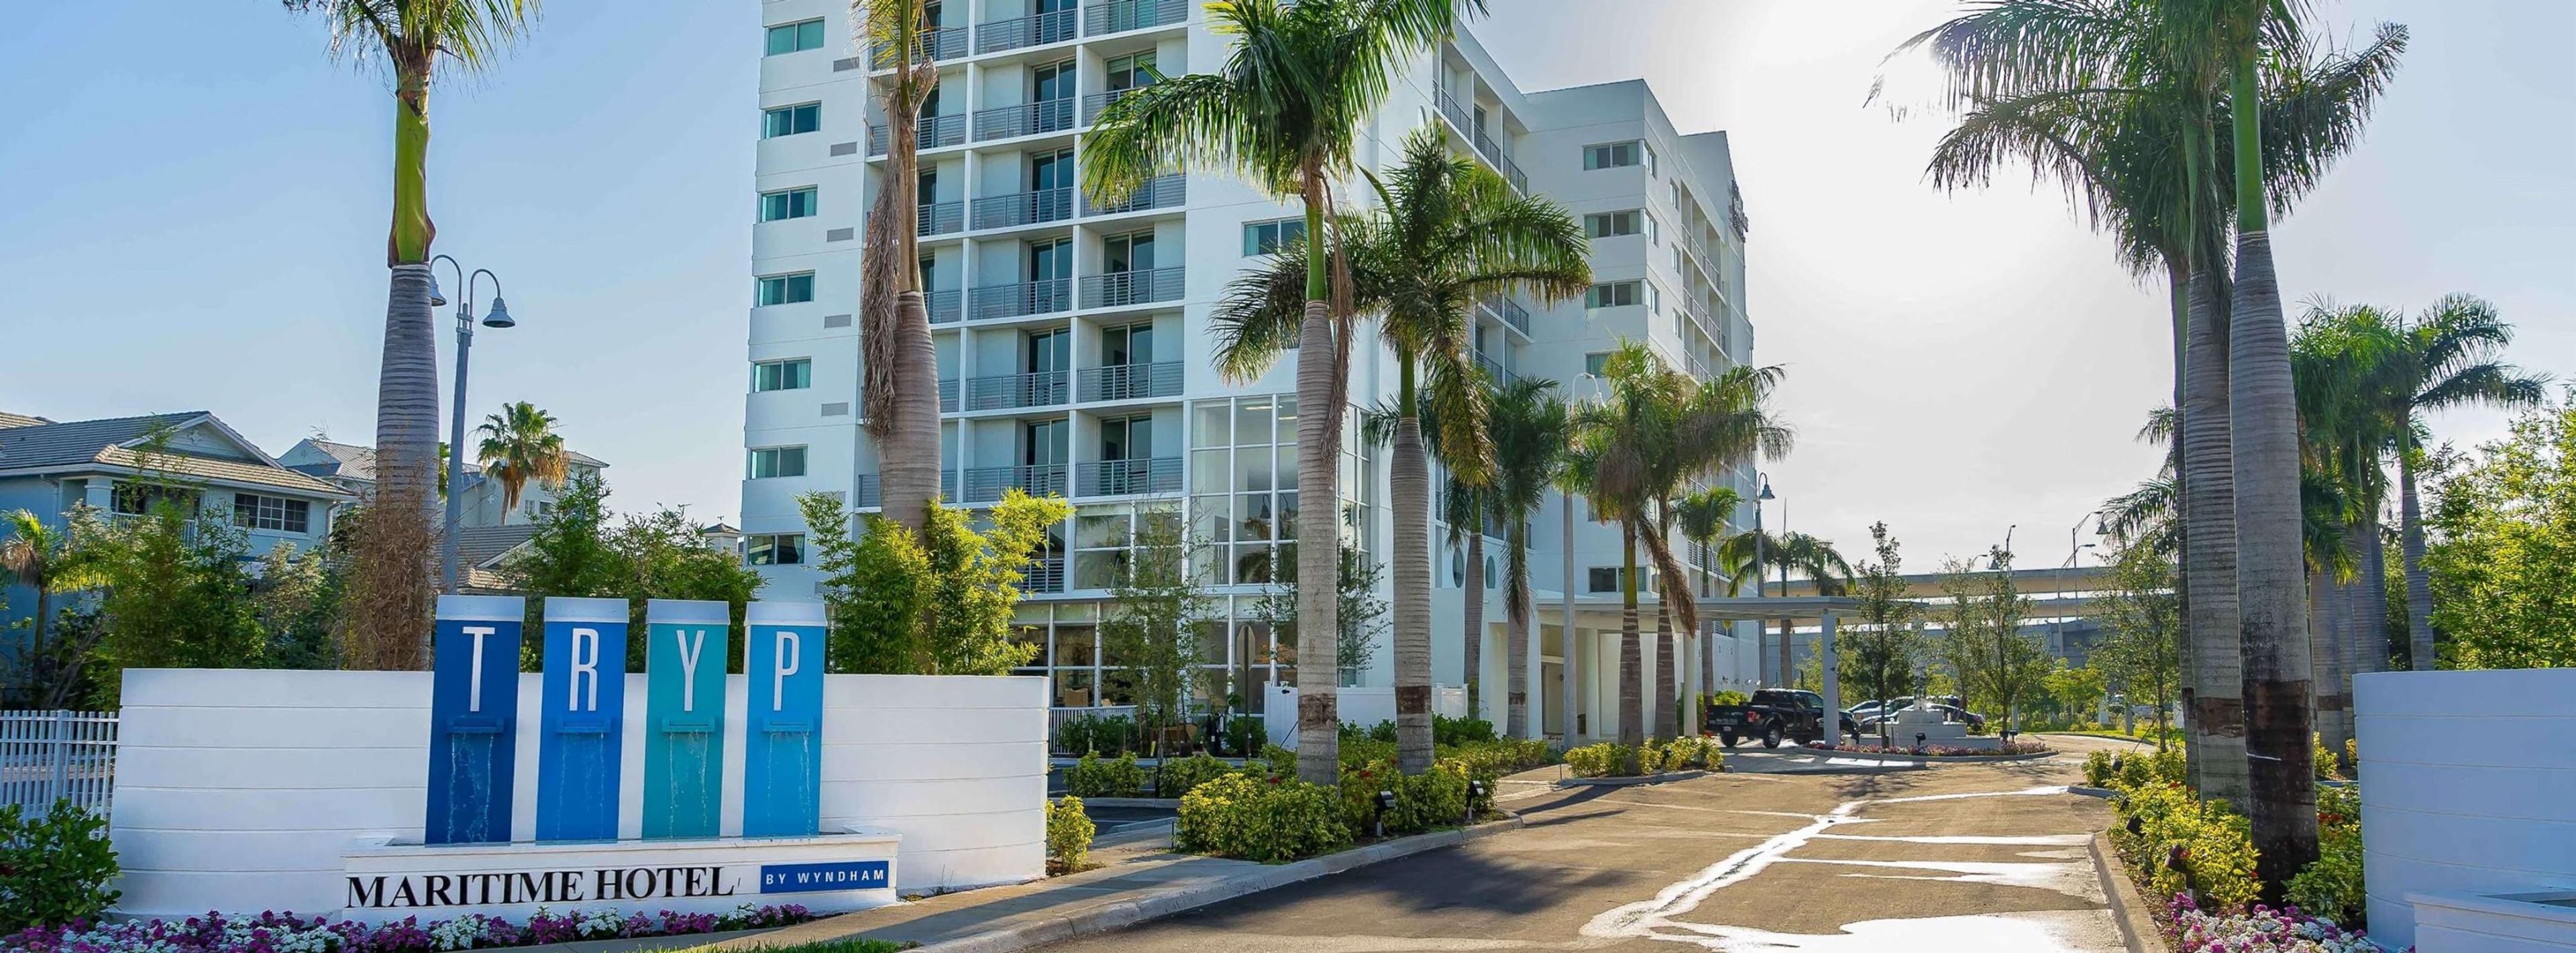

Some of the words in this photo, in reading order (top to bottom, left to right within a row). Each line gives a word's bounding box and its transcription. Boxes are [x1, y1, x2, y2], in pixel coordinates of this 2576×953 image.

[462, 626, 800, 712] TRYP
[345, 871, 584, 908] MARITIME
[594, 866, 735, 899] HOTEL
[765, 873, 786, 885] BY
[797, 869, 884, 884] WYNDHAM
